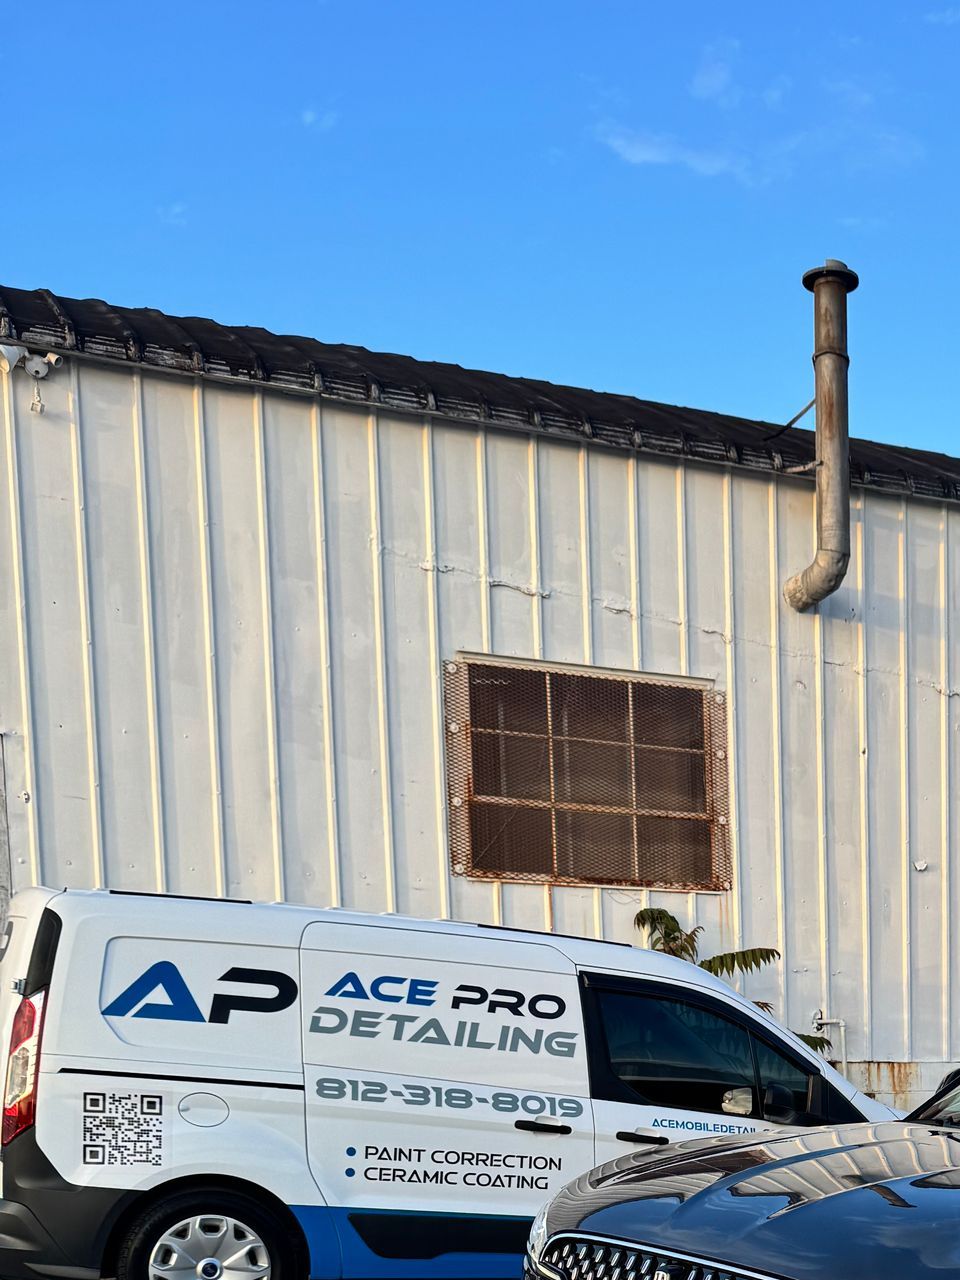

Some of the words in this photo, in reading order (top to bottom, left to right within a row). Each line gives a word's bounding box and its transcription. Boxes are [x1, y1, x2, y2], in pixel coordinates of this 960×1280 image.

[101, 961, 298, 1024] AP
[324, 971, 440, 1006] ACE
[451, 984, 566, 1020] PRO
[309, 1006, 579, 1058] DETAILING
[315, 1077, 584, 1118] 812-318-8019
[364, 1145, 426, 1163] PAINT
[431, 1150, 562, 1171] CORRECTION
[364, 1167, 458, 1185] CERAMIC
[463, 1173, 549, 1190] COATING
